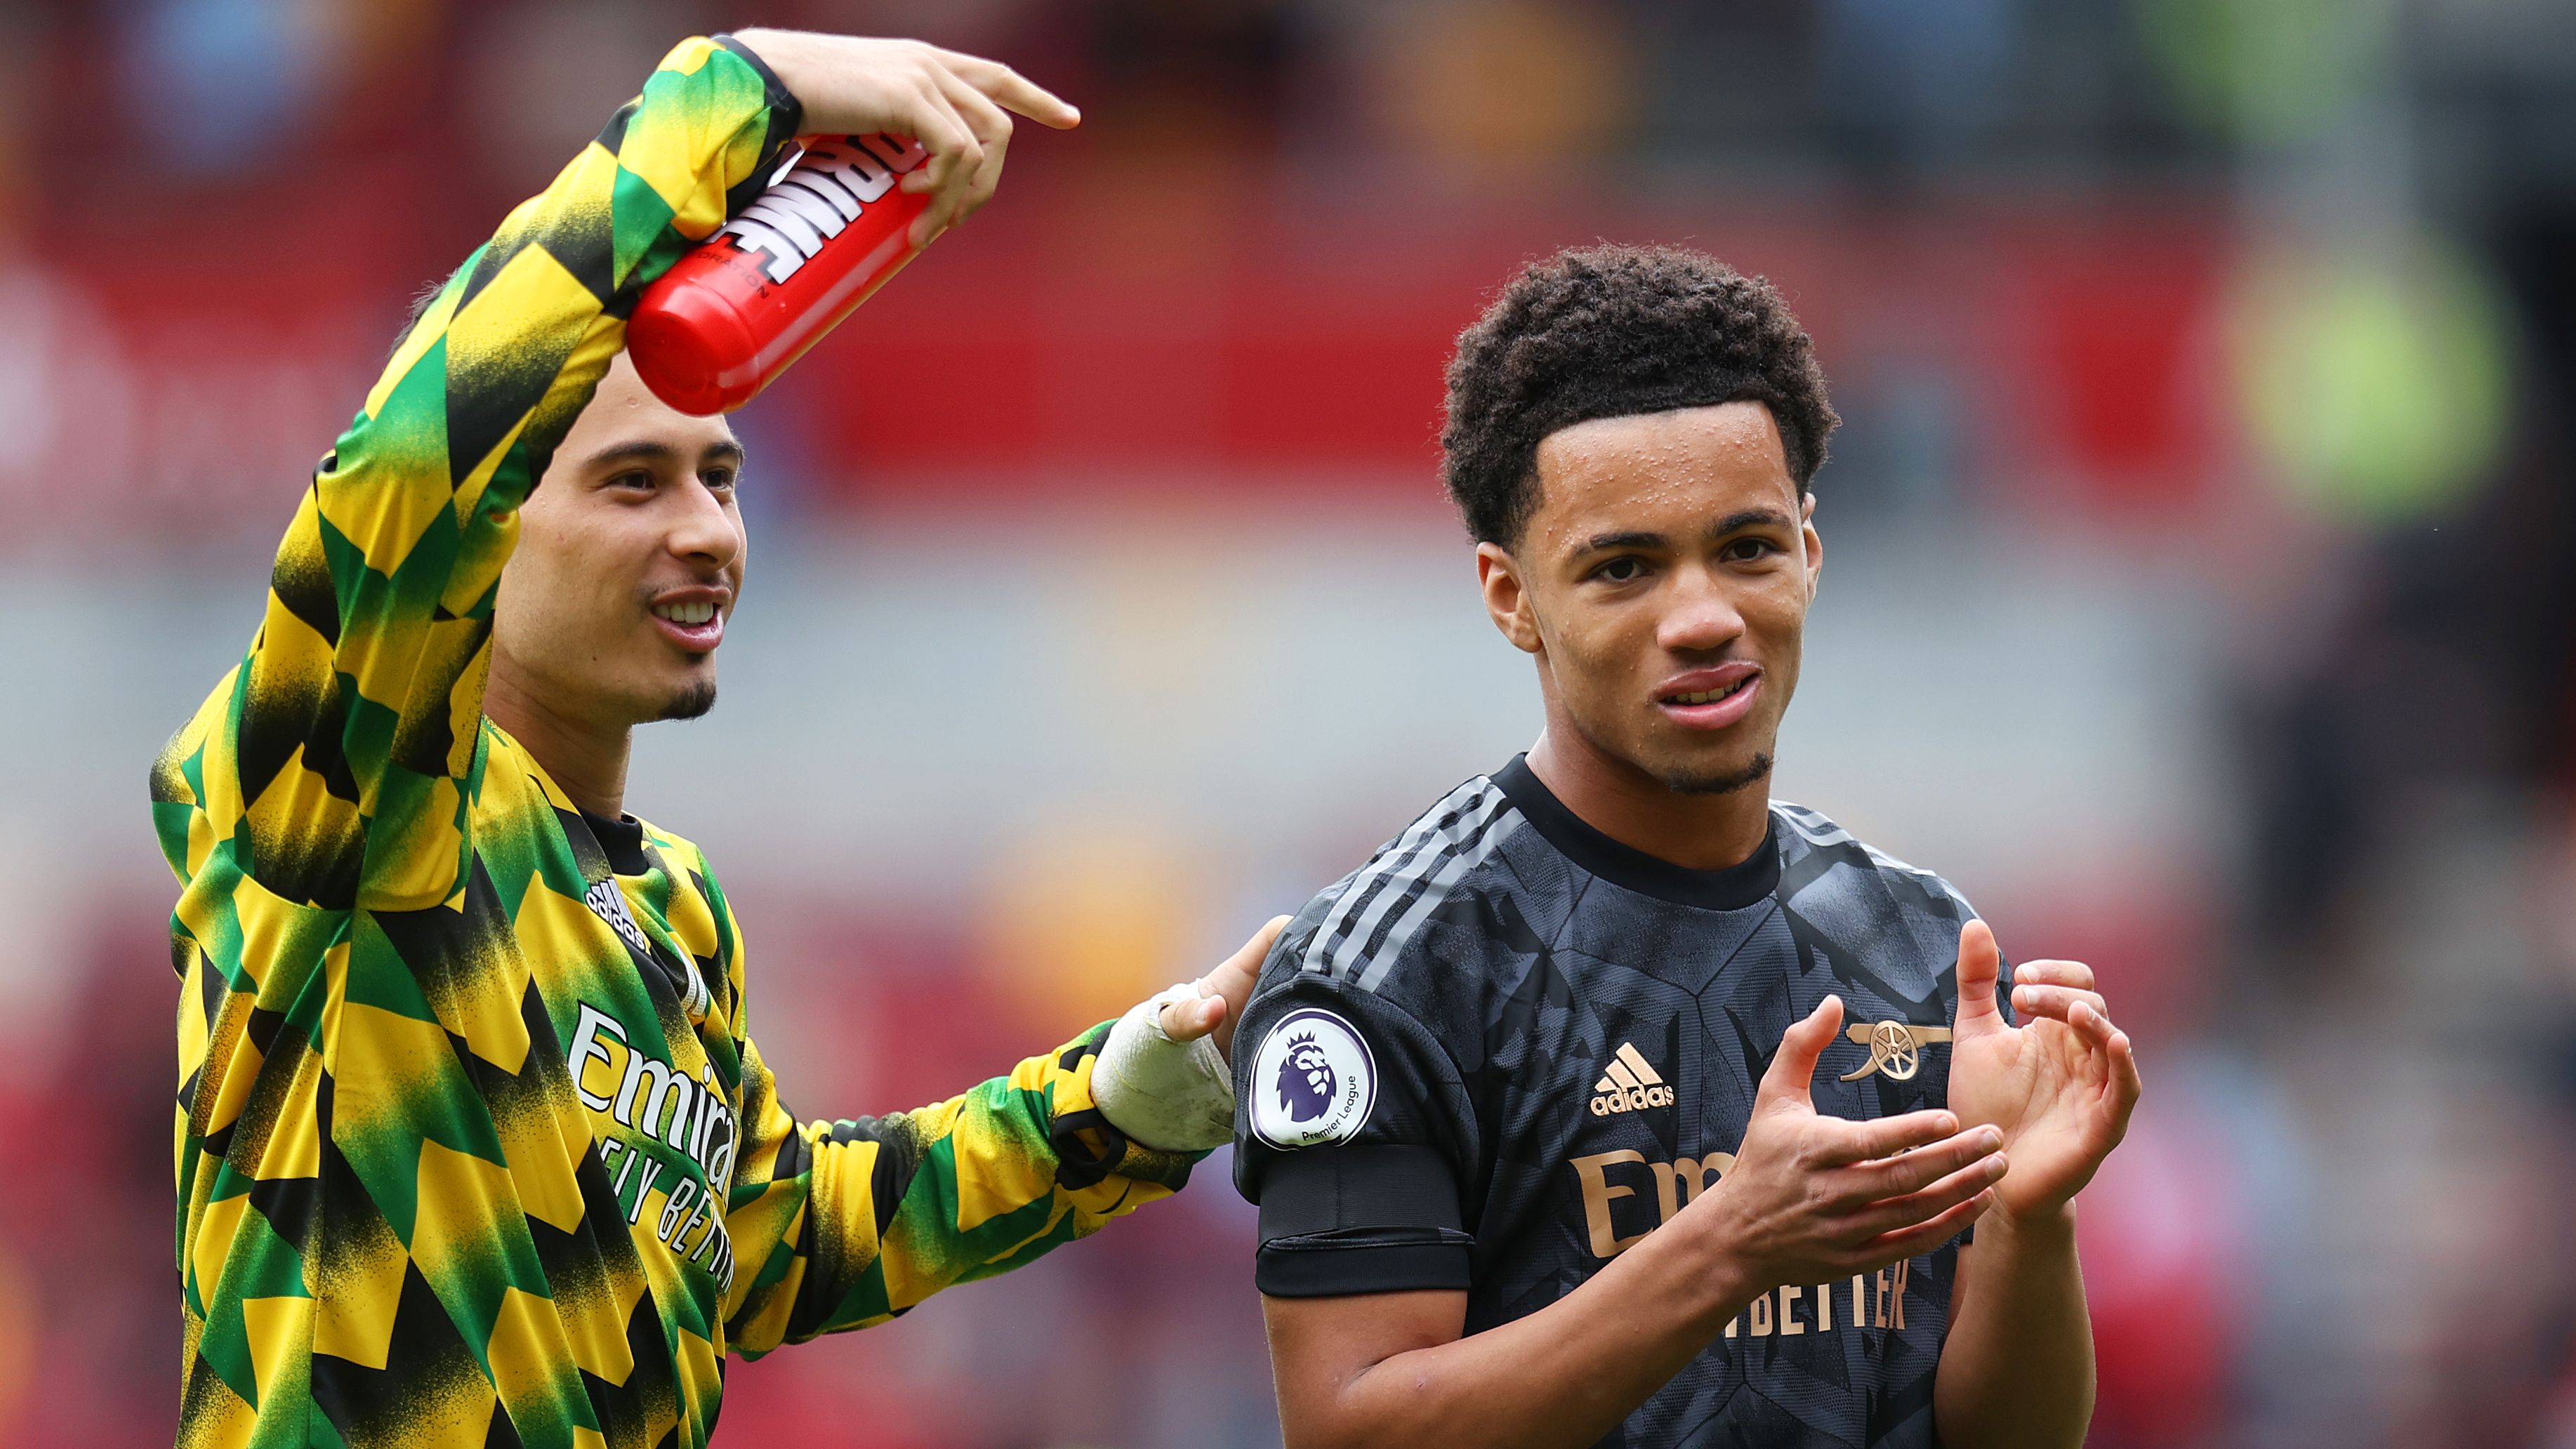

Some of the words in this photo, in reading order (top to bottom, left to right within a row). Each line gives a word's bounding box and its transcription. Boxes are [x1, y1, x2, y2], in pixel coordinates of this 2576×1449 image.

[585, 891, 646, 951] adidas
[1302, 1118, 1342, 1142] Premier
[1336, 1075, 1360, 1120] League
[1590, 1083, 1675, 1117] adidas
